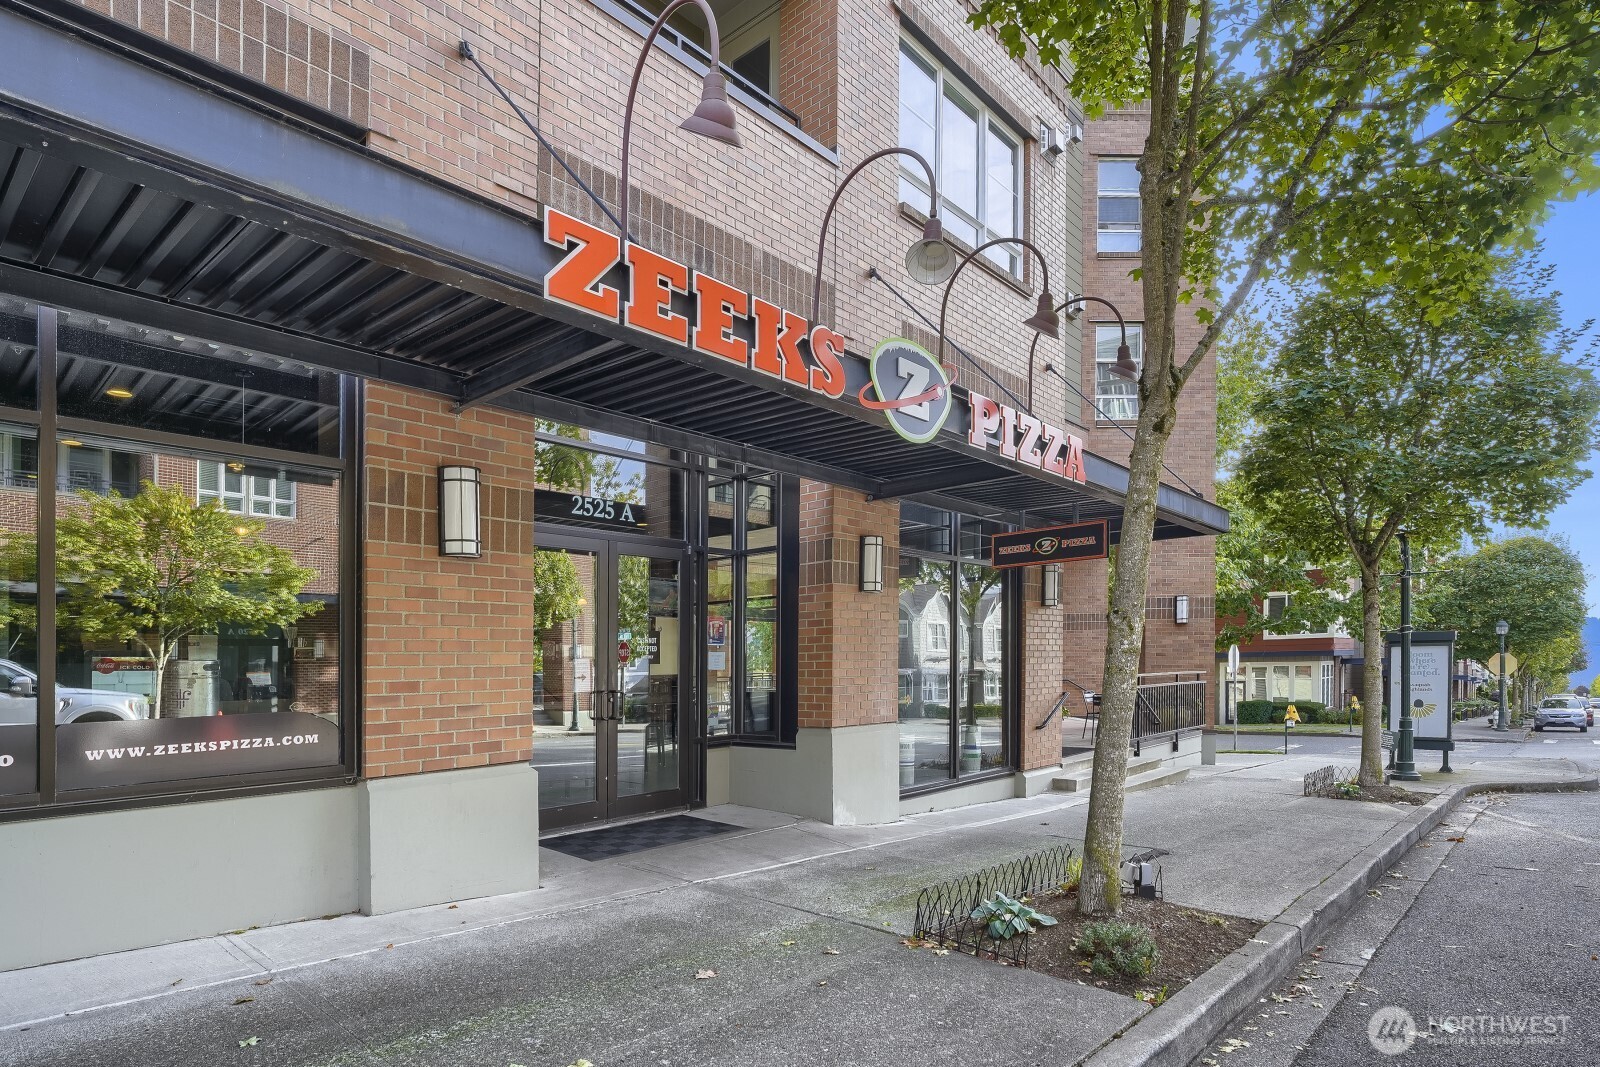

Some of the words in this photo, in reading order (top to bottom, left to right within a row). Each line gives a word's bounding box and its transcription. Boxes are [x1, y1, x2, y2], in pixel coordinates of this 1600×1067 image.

[544, 205, 846, 399] ZEEKS
[897, 356, 930, 422] Z
[968, 389, 1087, 485] PIZZA
[571, 495, 615, 519] 2525
[619, 503, 635, 522] A
[999, 544, 1031, 555] ZEEKS
[1061, 536, 1096, 547] PIZZA
[1410, 668, 1441, 677] anted.
[85, 734, 319, 761] WWW.ZEEKSPIZZA.COM
